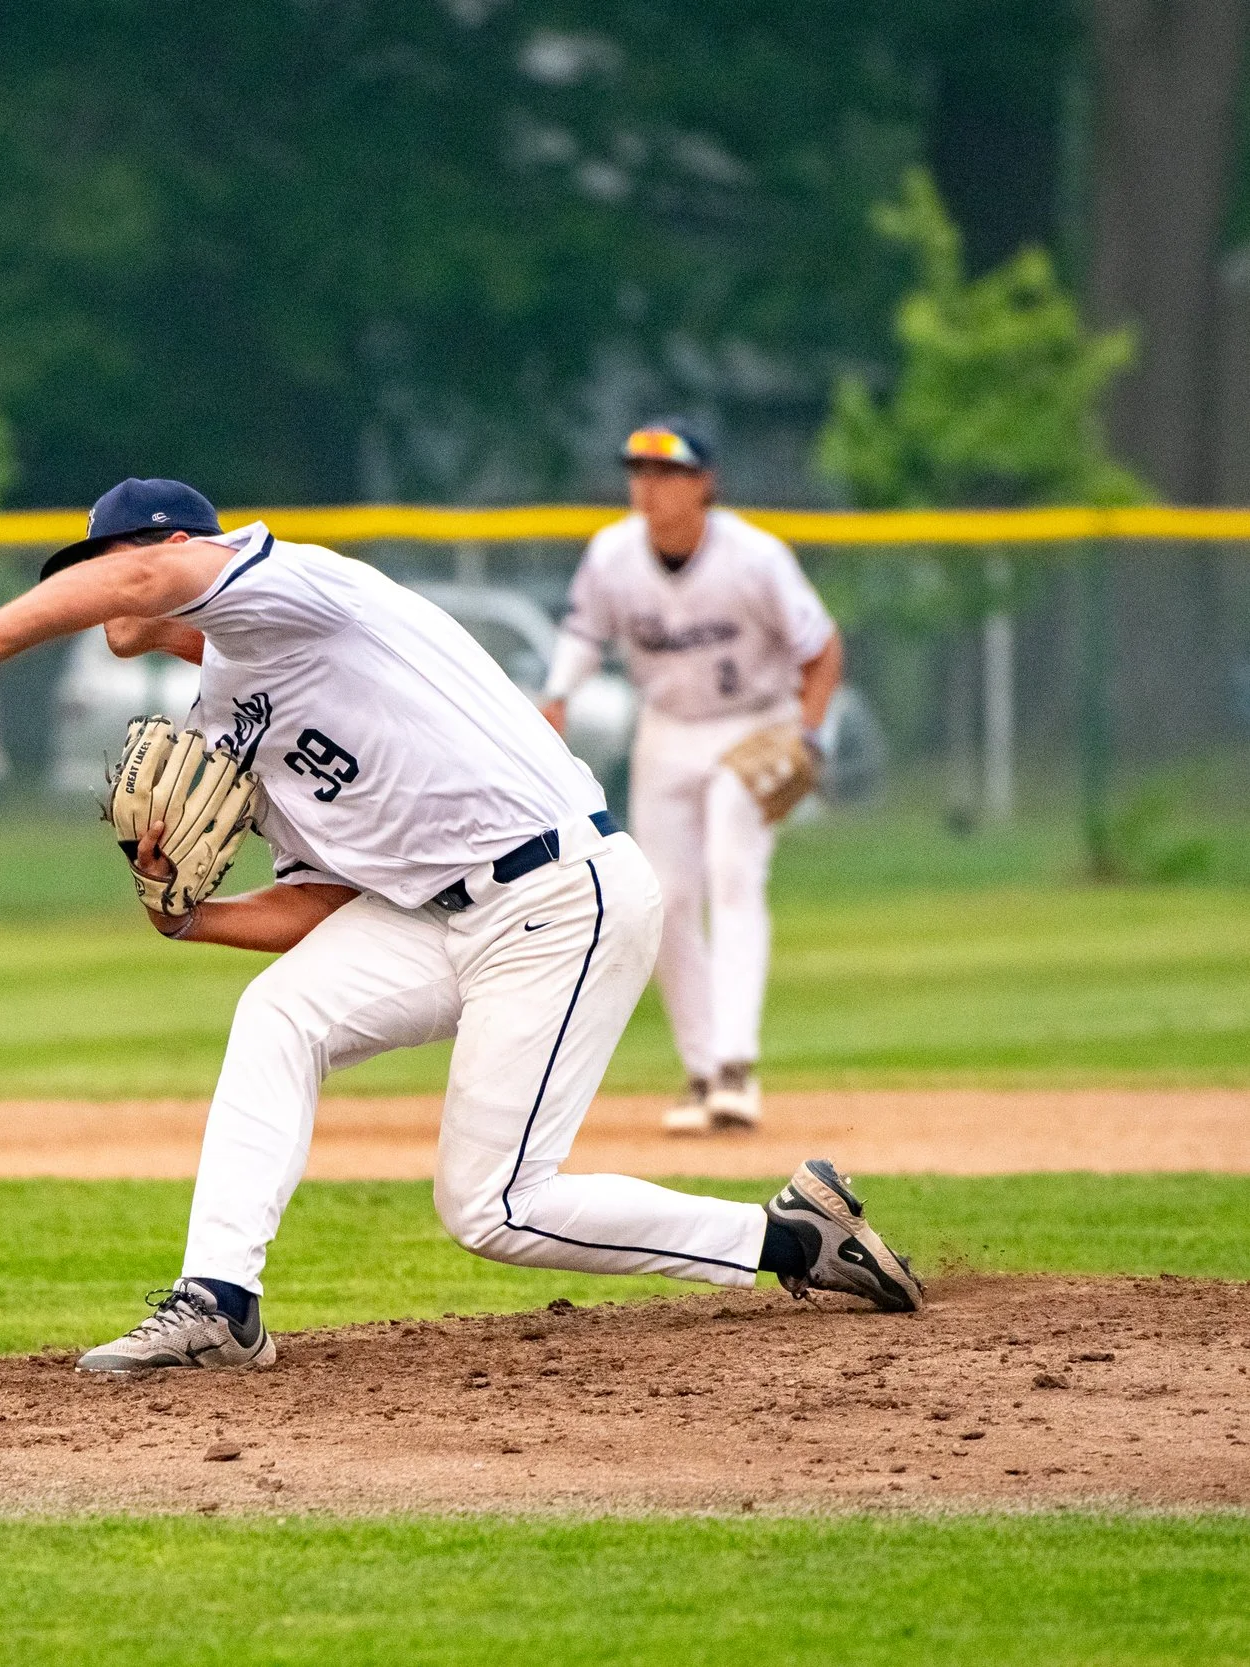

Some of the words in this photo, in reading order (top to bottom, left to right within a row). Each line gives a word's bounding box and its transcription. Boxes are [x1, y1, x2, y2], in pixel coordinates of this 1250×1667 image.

[126, 765, 139, 794] GREAT
[134, 741, 152, 764] LAKES
[283, 729, 359, 802] 39
